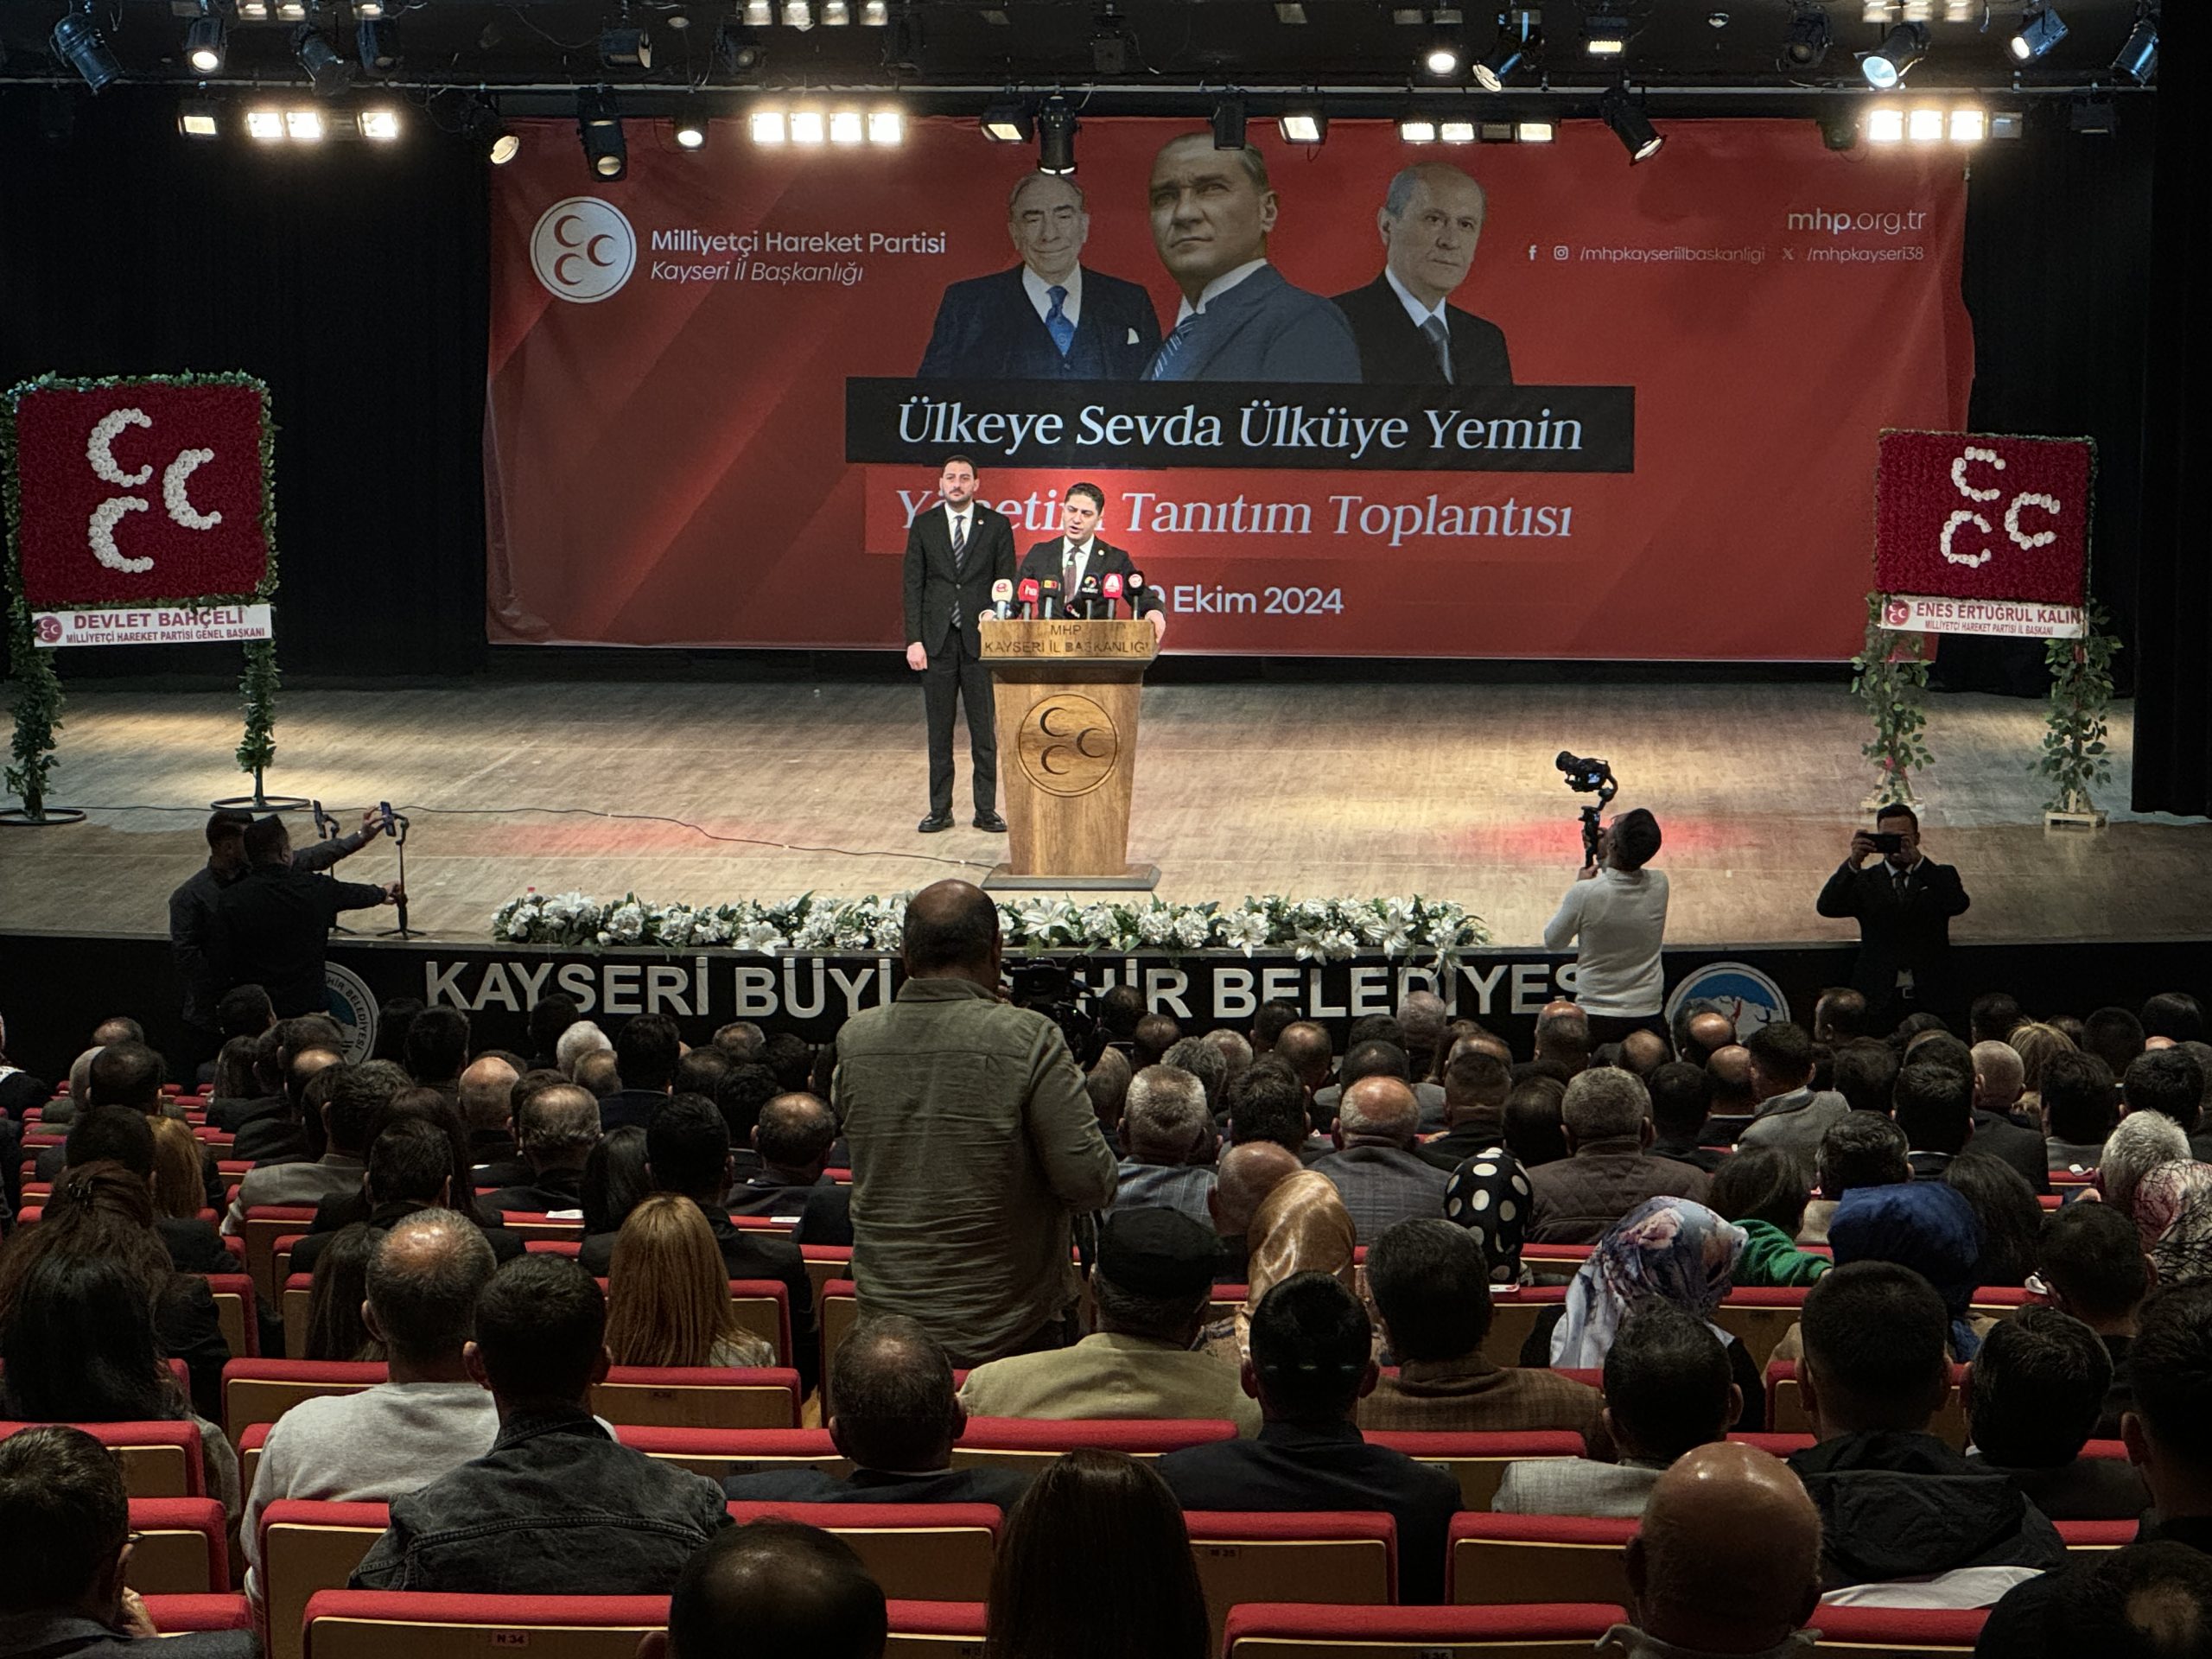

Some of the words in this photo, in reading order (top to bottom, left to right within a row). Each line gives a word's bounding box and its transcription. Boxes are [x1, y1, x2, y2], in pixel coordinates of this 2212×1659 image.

[1788, 207, 1927, 235] mhp.org.tr
[651, 229, 759, 257] Milliyetçi
[766, 232, 862, 252] Hareket
[868, 232, 946, 254] Partisi
[1808, 246, 1924, 263] /mhpkayseri38
[651, 262, 729, 283] Kayseri
[734, 258, 746, 280] İl
[751, 262, 863, 286] Başkanlığı
[899, 395, 1064, 455] Ülkeye
[1077, 404, 1223, 447] Sevda
[1239, 399, 1408, 459] Ülküye
[1423, 410, 1583, 451] Yemin
[1122, 492, 1313, 533] Tanıtım
[1329, 494, 1572, 547] Toplantısı
[1174, 584, 1256, 613] Ekim
[1264, 587, 1344, 614] 2024
[74, 613, 151, 629] DEVLET
[158, 607, 244, 628] BAHÇELİ
[1916, 602, 1953, 617] ENES
[1958, 604, 2032, 621] ERTUĞRUL
[2037, 608, 2081, 625] KALIN
[67, 630, 113, 643] MİLLİYETÇİ
[117, 632, 157, 641] HAREKET
[161, 630, 194, 640] PARTİSİ
[196, 629, 224, 639] GENEL
[226, 627, 264, 639] BAŞKANI
[1050, 625, 1082, 635] MHP
[1925, 620, 1960, 631] MİLLİYETÇİ
[1962, 622, 1991, 632] HAREKET
[1993, 623, 2016, 633] PARTİSİ
[985, 641, 1045, 653] KAYSERİ
[1050, 640, 1060, 652] İL
[426, 957, 709, 1016] KAYSERİ
[496, 1634, 506, 1643] N
[509, 1635, 524, 1644] 34
